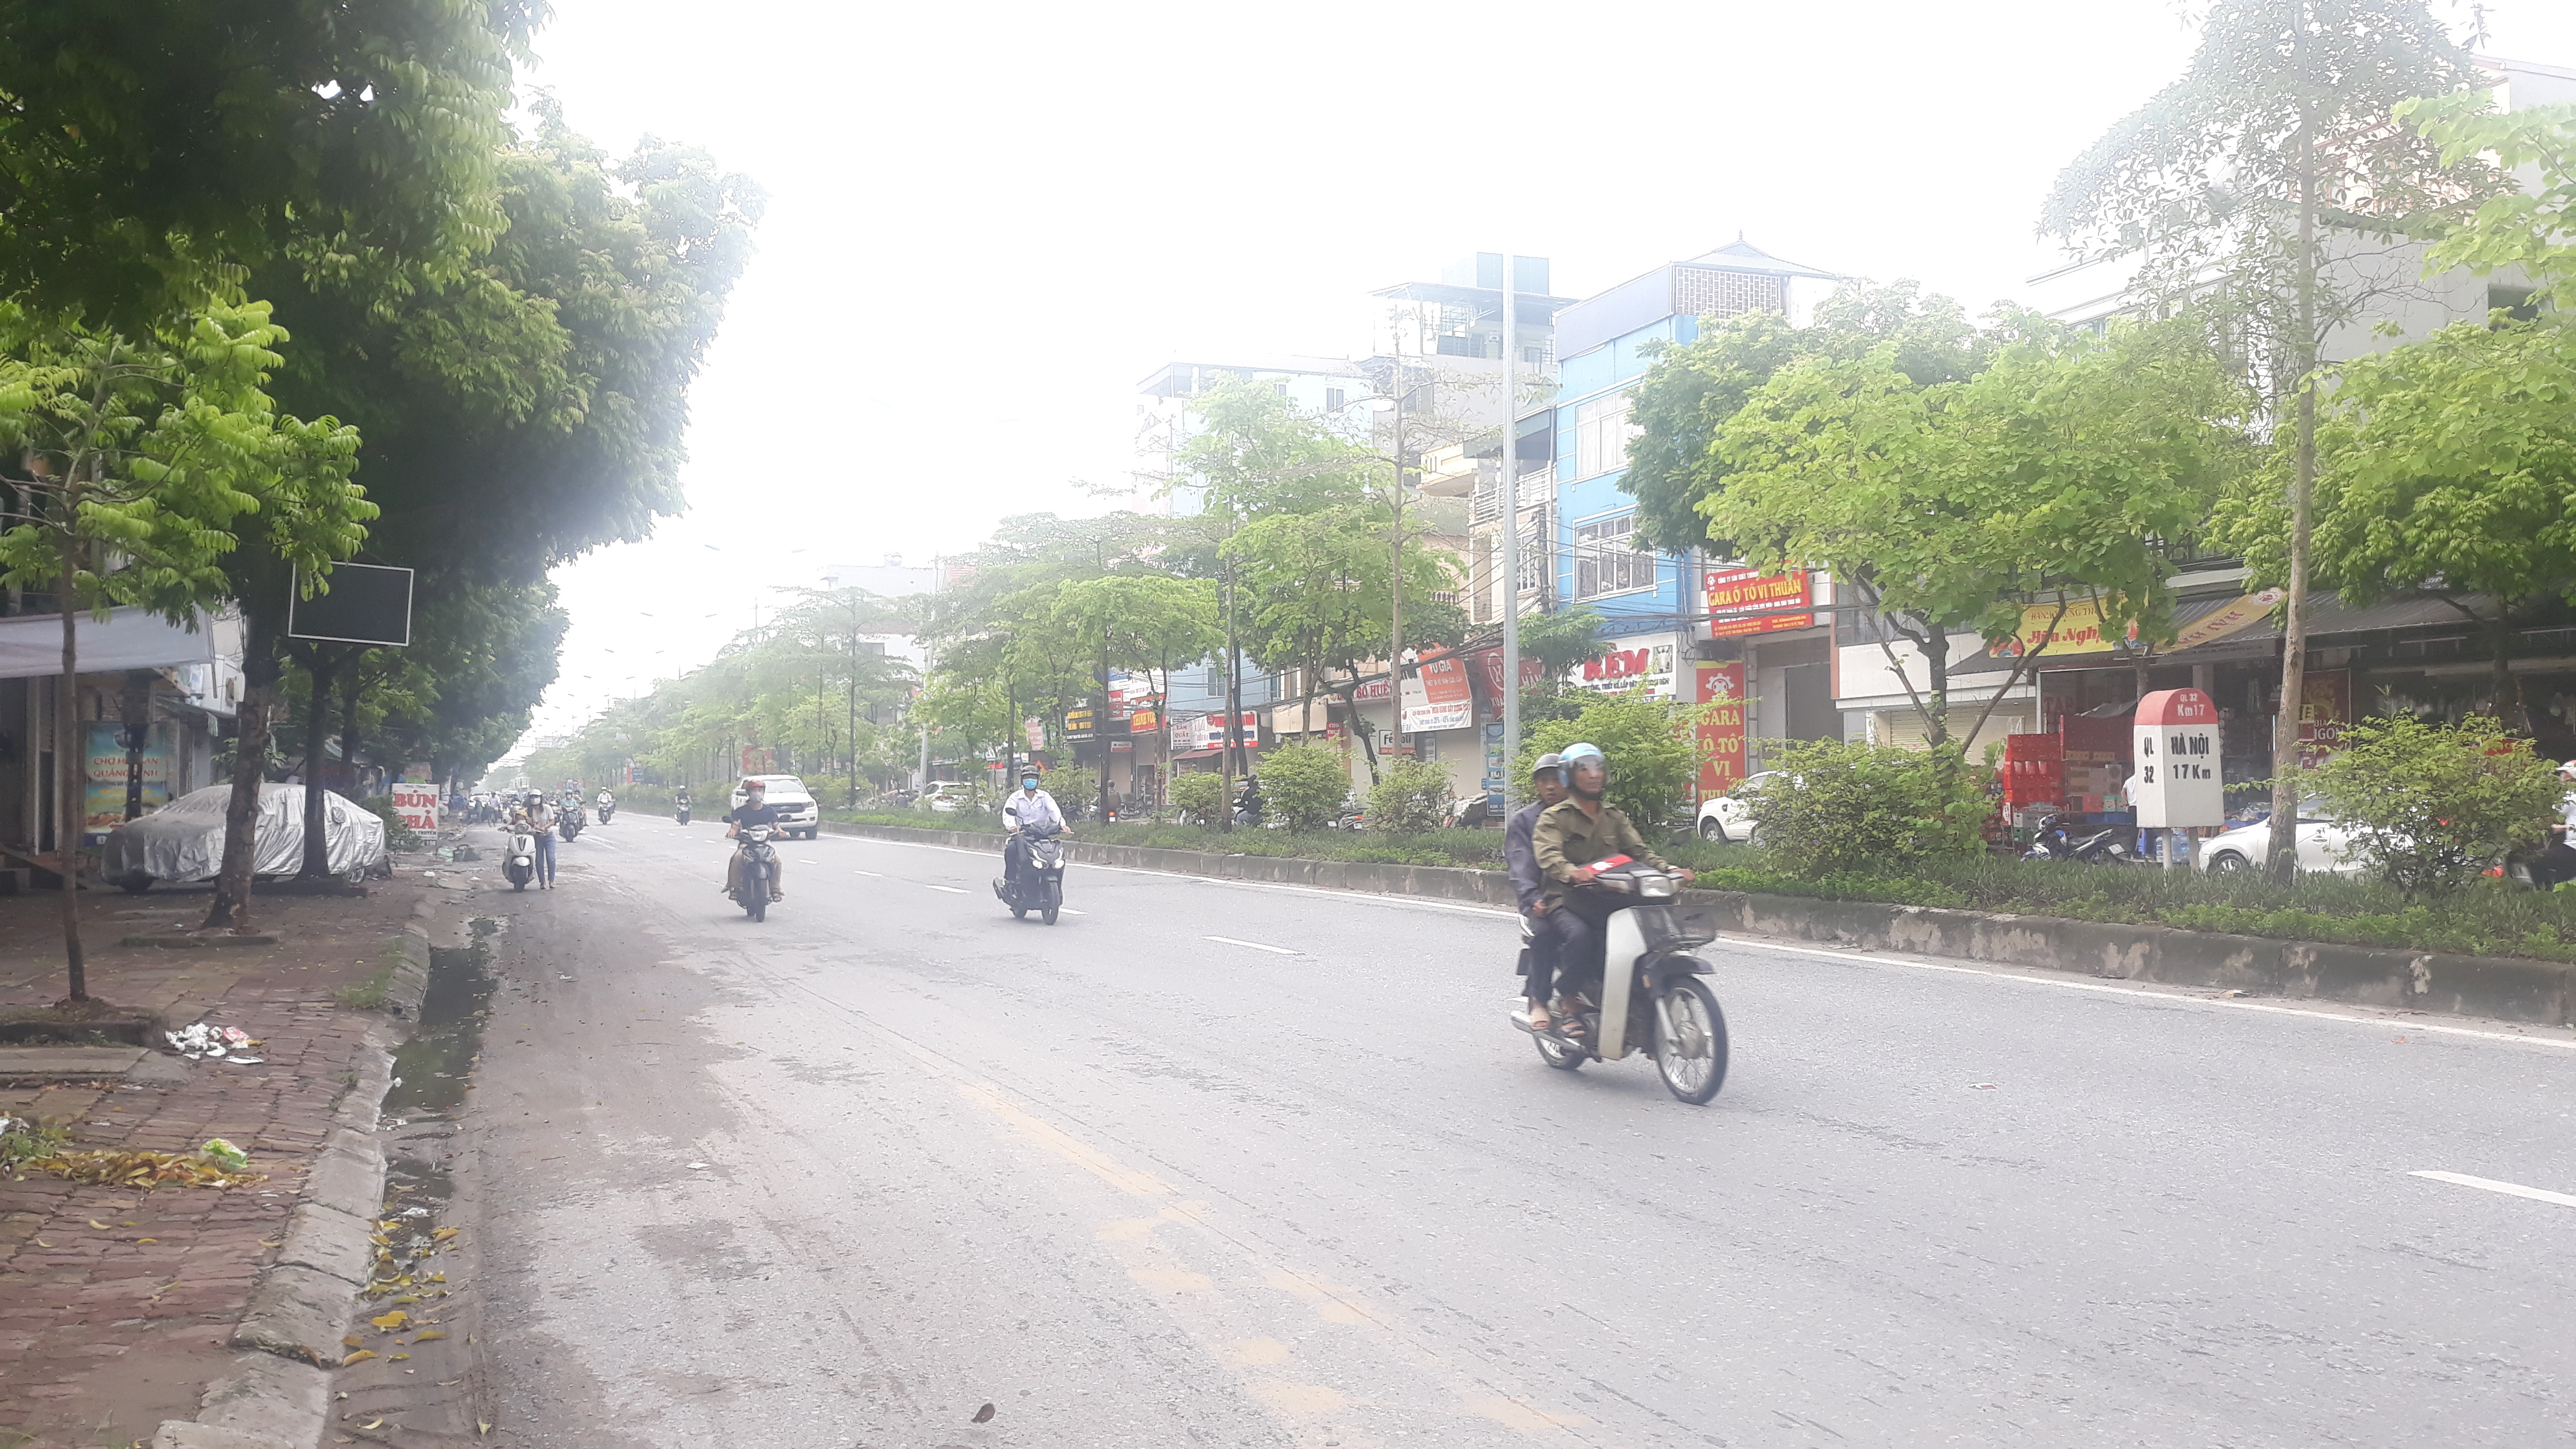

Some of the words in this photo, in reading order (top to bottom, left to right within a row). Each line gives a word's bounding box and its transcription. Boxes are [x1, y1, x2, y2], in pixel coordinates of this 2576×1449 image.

[1708, 590, 1733, 607] GARA
[1733, 585, 1741, 603] Ô
[1743, 583, 1757, 602] TÔ
[1757, 584, 1769, 602] VỊ
[1769, 578, 1802, 598] THUẬN
[2189, 693, 2198, 702] 32
[1700, 710, 1741, 726] GARA
[1702, 733, 1714, 752] Ô
[1717, 733, 1739, 753] TÔ
[2144, 736, 2154, 758] QL
[2170, 733, 2187, 755] HÀ
[2189, 733, 2210, 759] NỘI
[1712, 761, 1731, 781] VỊ
[2144, 765, 2154, 784] 32
[393, 789, 437, 808] BÚN
